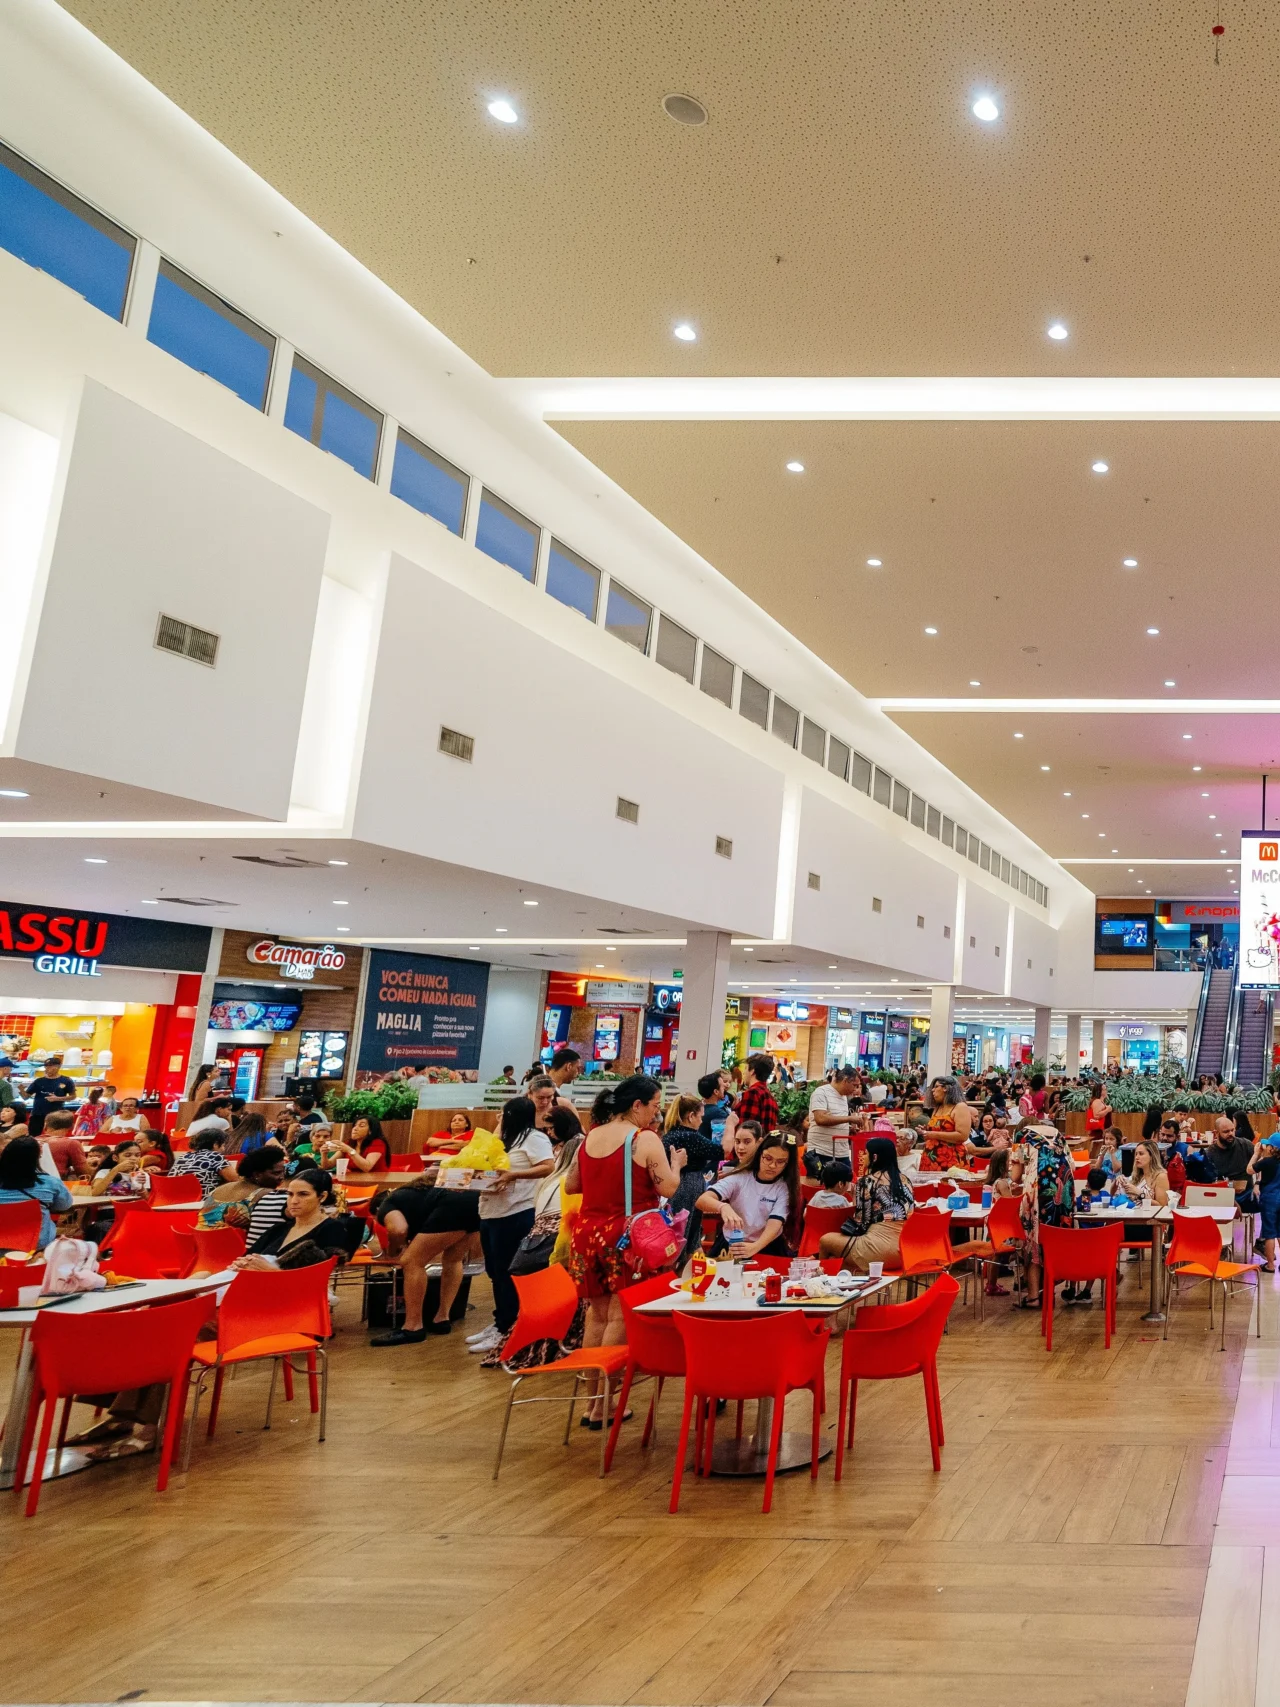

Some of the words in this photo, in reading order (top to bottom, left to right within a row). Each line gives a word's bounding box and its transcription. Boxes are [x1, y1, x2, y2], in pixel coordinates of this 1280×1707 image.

[254, 942, 344, 968] Camarão
[36, 955, 102, 977] GRILL
[381, 969, 413, 987] VOCÊ
[413, 973, 449, 990] NUNCA
[379, 987, 420, 1004] COMEU
[421, 990, 449, 1006] NADA
[450, 992, 477, 1008] IGUAL
[376, 1012, 422, 1032] MAGLIA
[433, 1023, 454, 1031] conhecer
[434, 1014, 449, 1022] Pronto
[1129, 1027, 1143, 1036] yoggi
